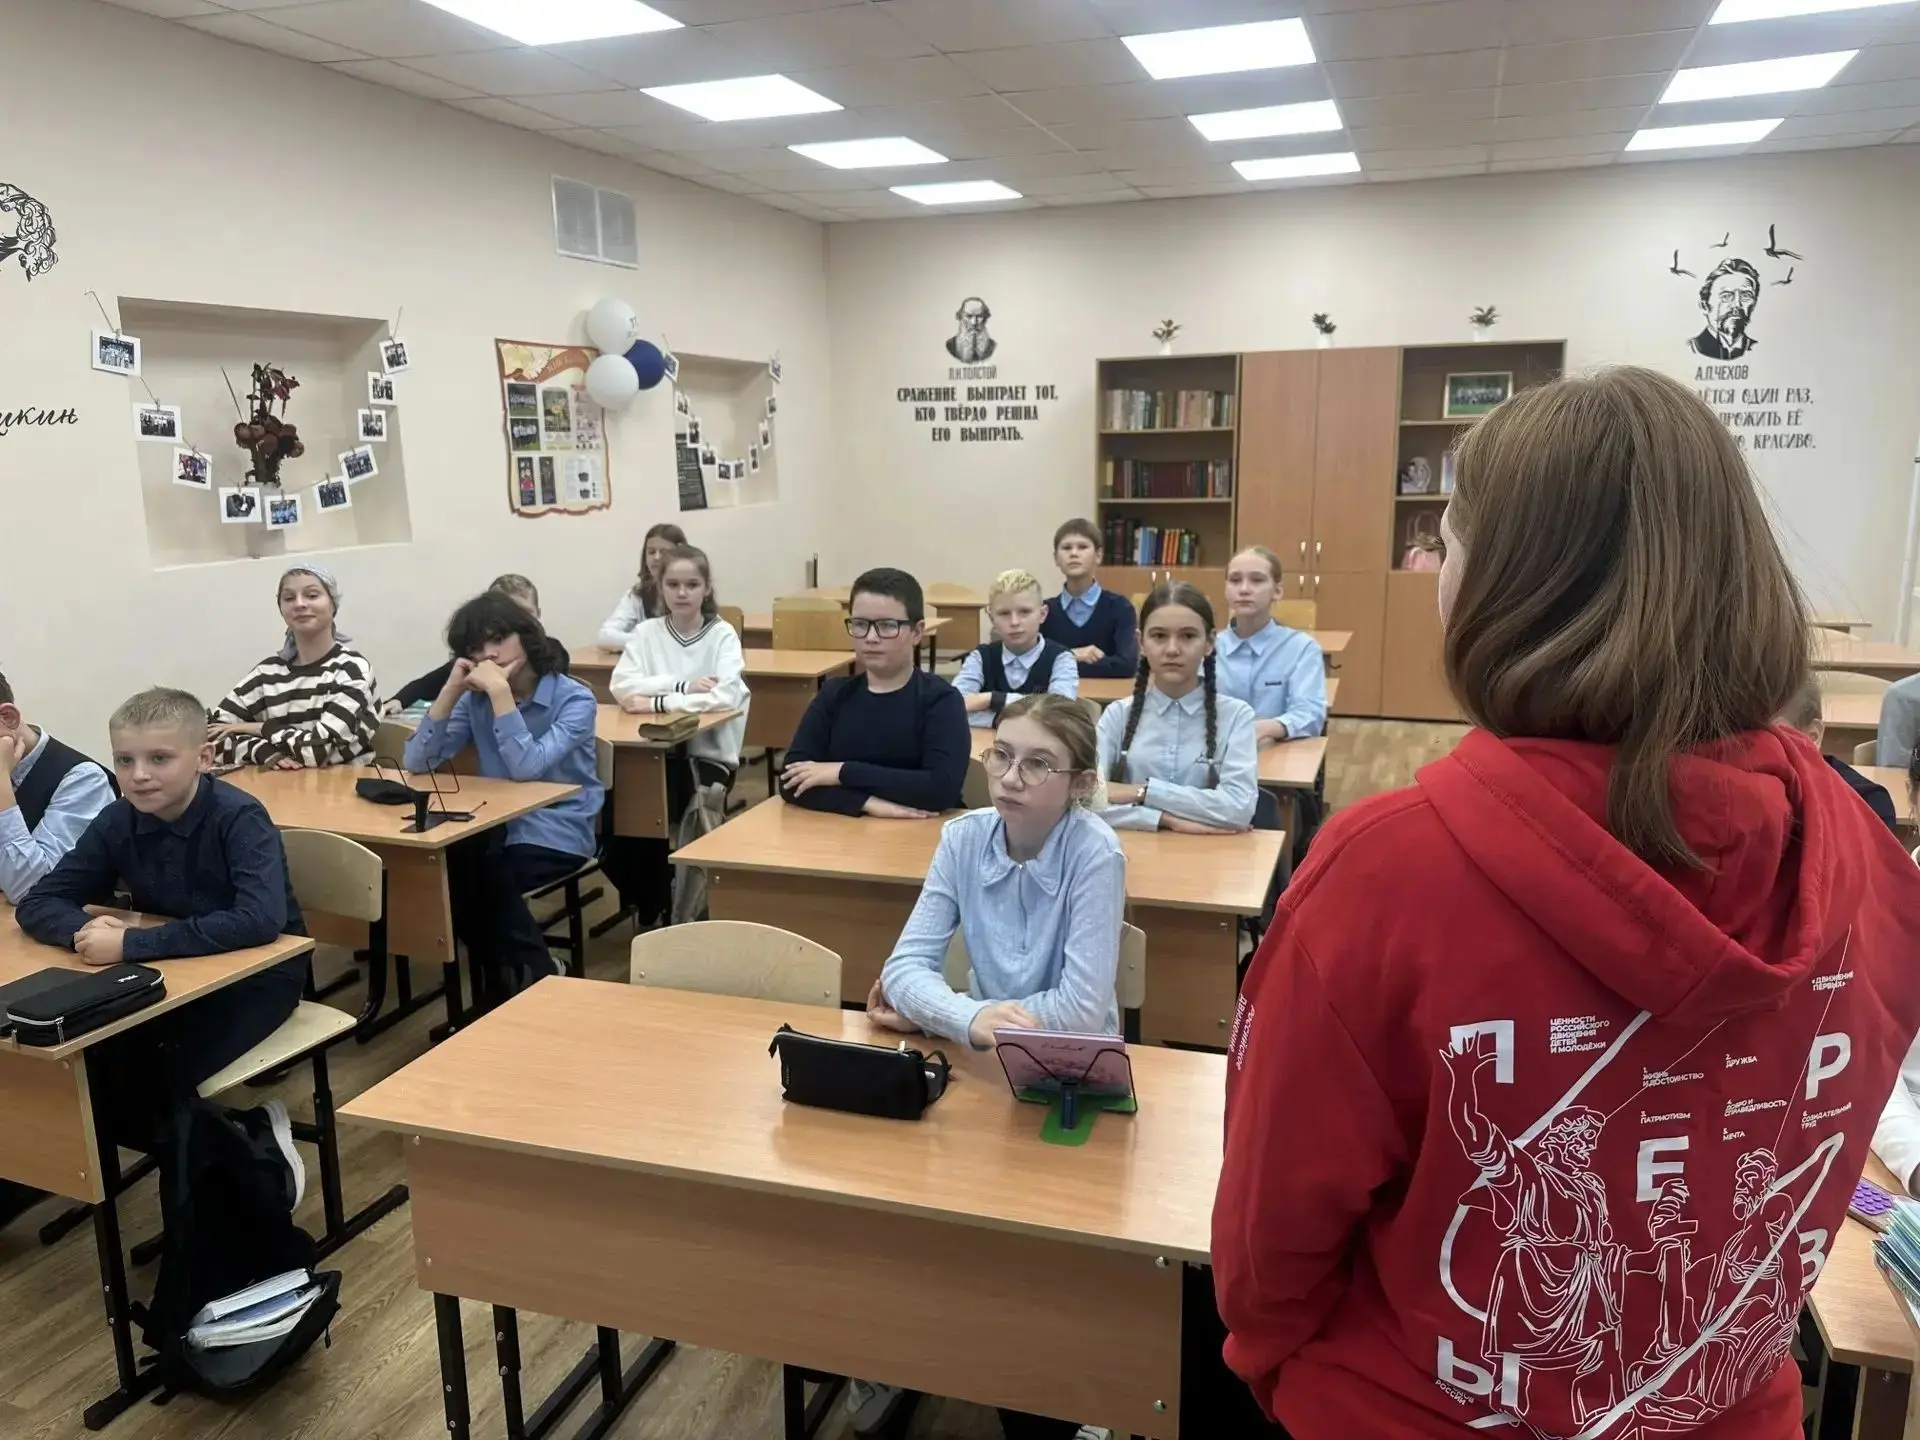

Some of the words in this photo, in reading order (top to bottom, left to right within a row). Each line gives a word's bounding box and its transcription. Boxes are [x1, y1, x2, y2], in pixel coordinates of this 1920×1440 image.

[897, 387, 957, 402] СРАЖЕНИЕ
[967, 386, 1027, 401] ВЫИГРАЕТ
[1742, 387, 1779, 404] ОДИН
[915, 407, 936, 421] КТО
[945, 404, 987, 422] ТВЁРДО
[996, 405, 1038, 421] РЕШИЛ
[932, 427, 951, 442] ЕГО
[960, 426, 1023, 442] ВЫИГРАТЬ.
[1754, 433, 1816, 449] КРАСИВО.
[1550, 1015, 1596, 1026] ЦЕННОСТИ
[1550, 1020, 1610, 1033] РОССИЙСКОГО
[1550, 1029, 1597, 1041] ДВИЖЕНИЯ
[1550, 1038, 1577, 1047] ДЕТЕЙ
[1550, 1046, 1557, 1054] И
[1558, 1041, 1607, 1053] МОЛОДЁЖИ
[1725, 1055, 1758, 1069] ДРУЖБА
[1805, 1032, 1851, 1101] Р
[1640, 1112, 1691, 1124] ПАТРИОТИЗМ
[1722, 1130, 1746, 1141] МЕЧТА
[1636, 1136, 1689, 1203] Е
[1434, 1379, 1466, 1406] РОССИИ
